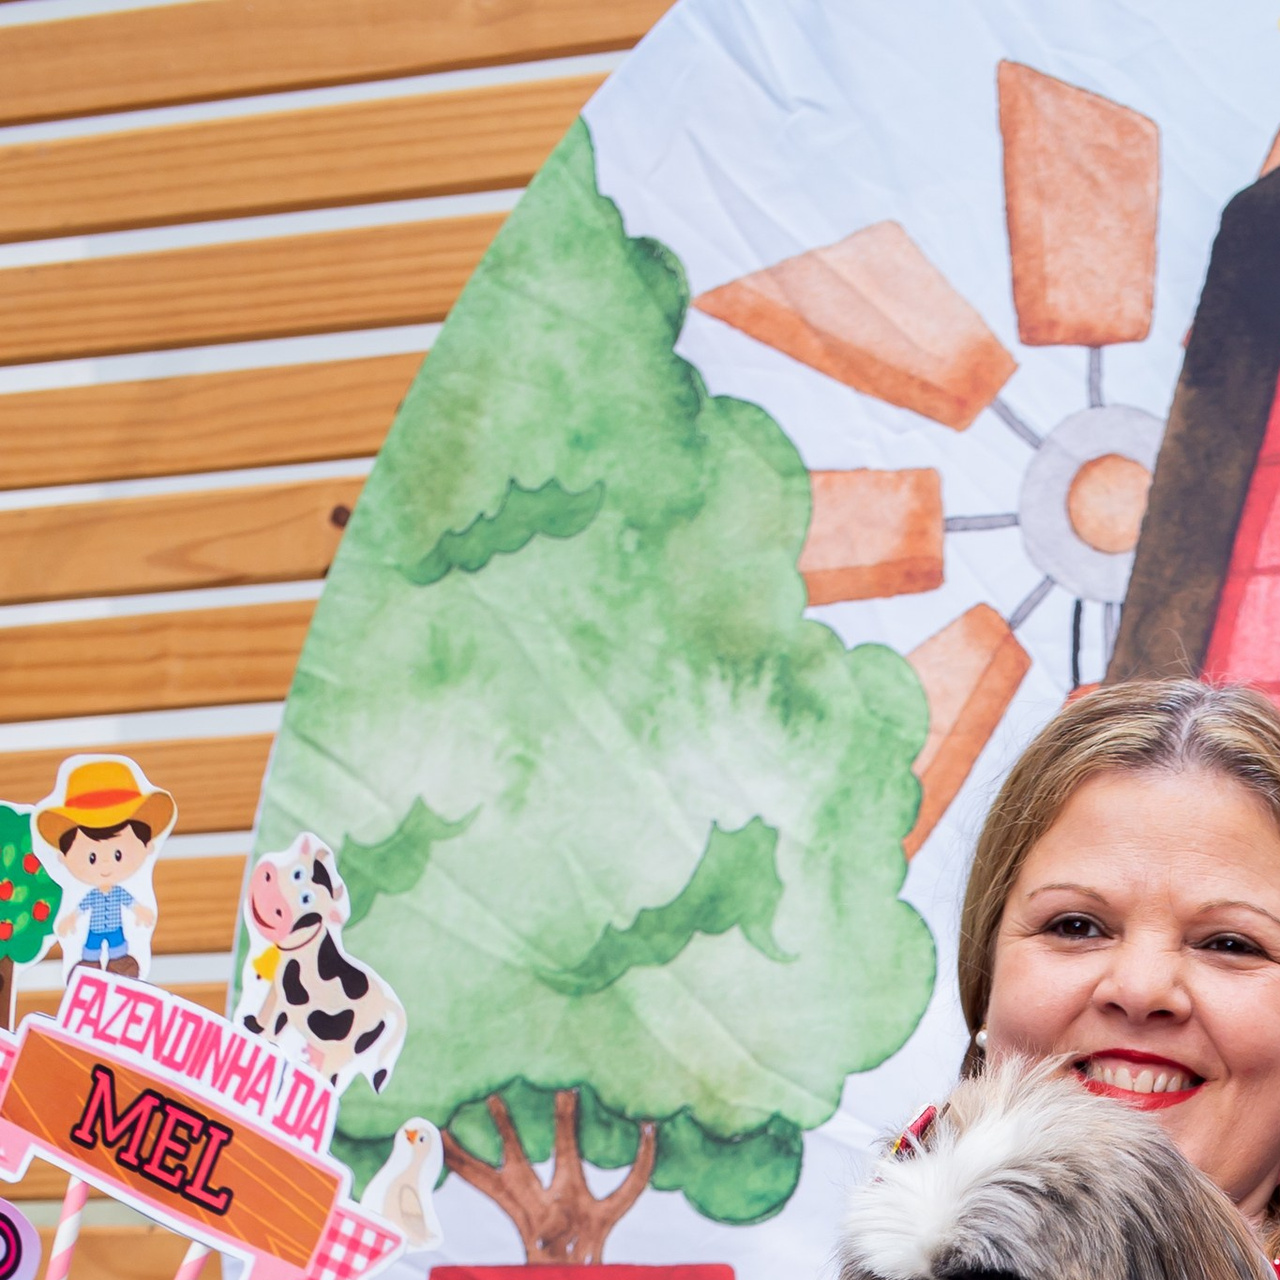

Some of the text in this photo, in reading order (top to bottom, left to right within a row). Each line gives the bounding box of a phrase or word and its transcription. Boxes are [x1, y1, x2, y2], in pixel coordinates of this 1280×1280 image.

[62, 974, 332, 1154] FAZENDINHA DA
[71, 1065, 232, 1215] MEL
